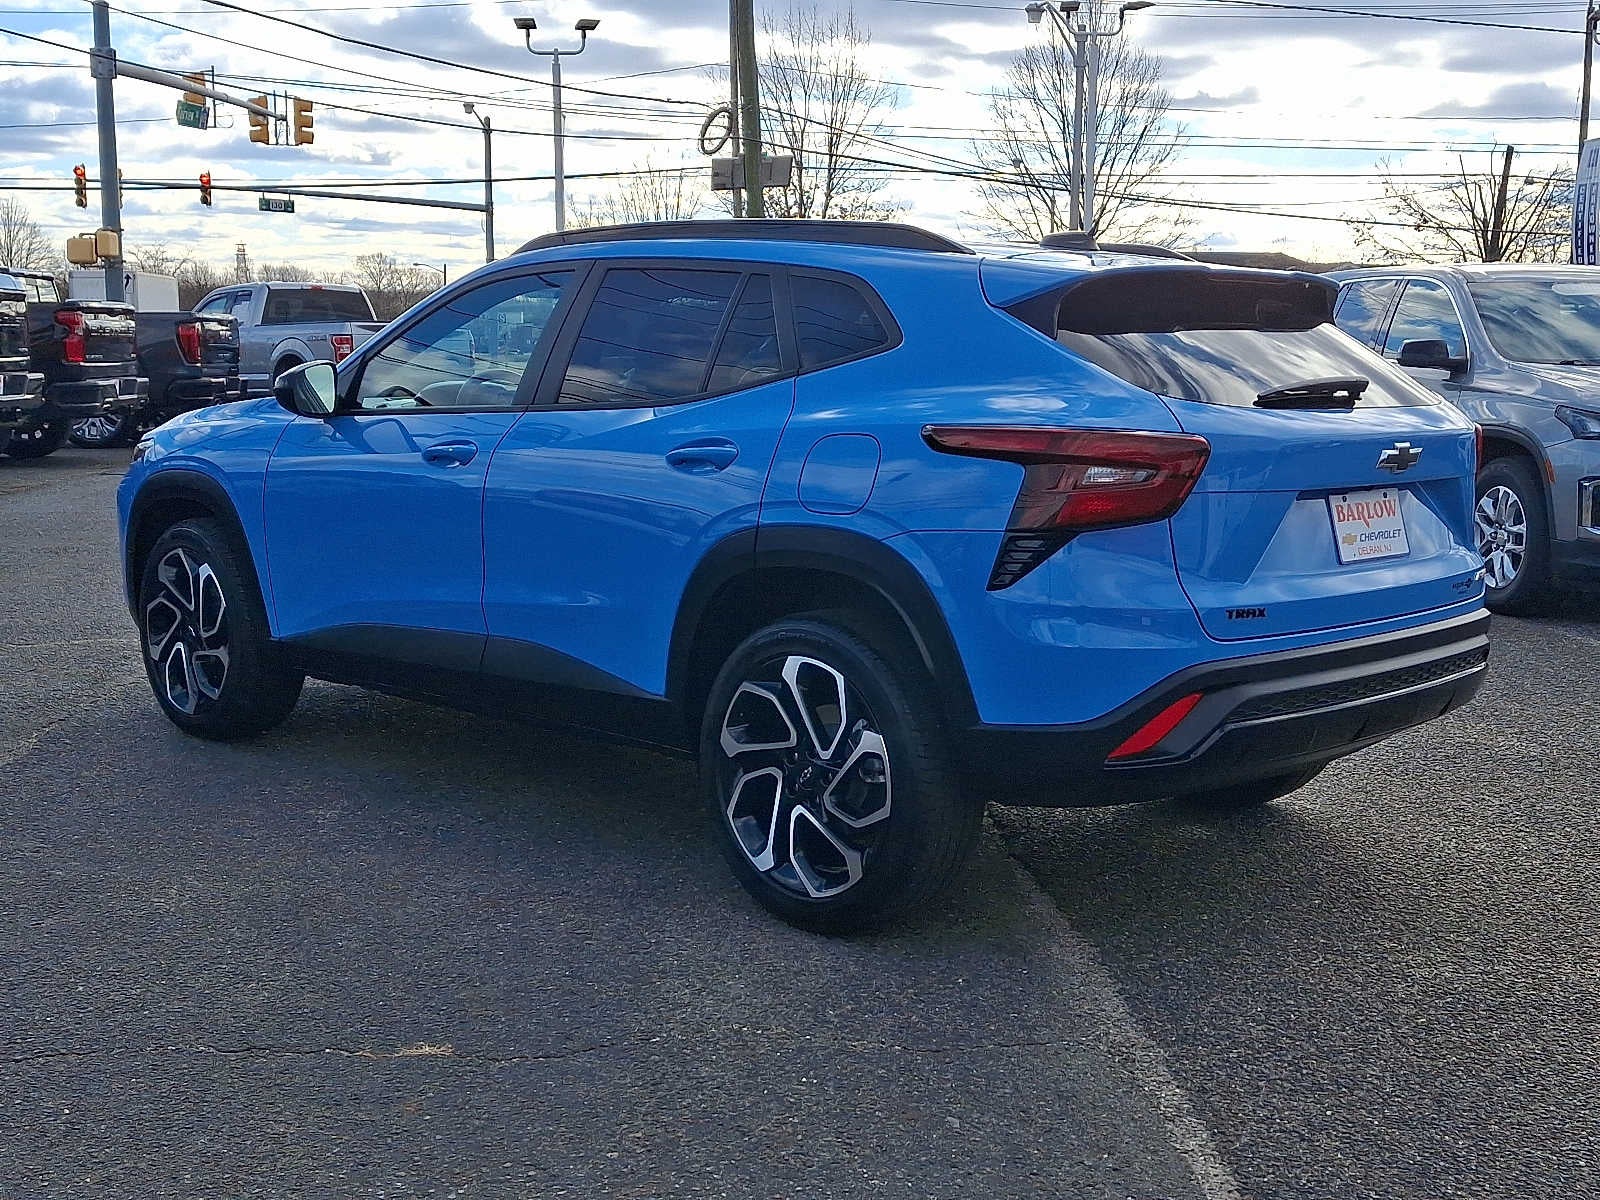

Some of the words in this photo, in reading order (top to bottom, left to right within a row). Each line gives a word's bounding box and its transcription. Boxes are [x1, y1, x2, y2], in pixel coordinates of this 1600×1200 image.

[1576, 185, 1586, 263] CERTIFIED
[1335, 499, 1396, 528] BARLOW
[1360, 529, 1402, 542] CHEVROLET
[1225, 607, 1267, 619] TRAX
